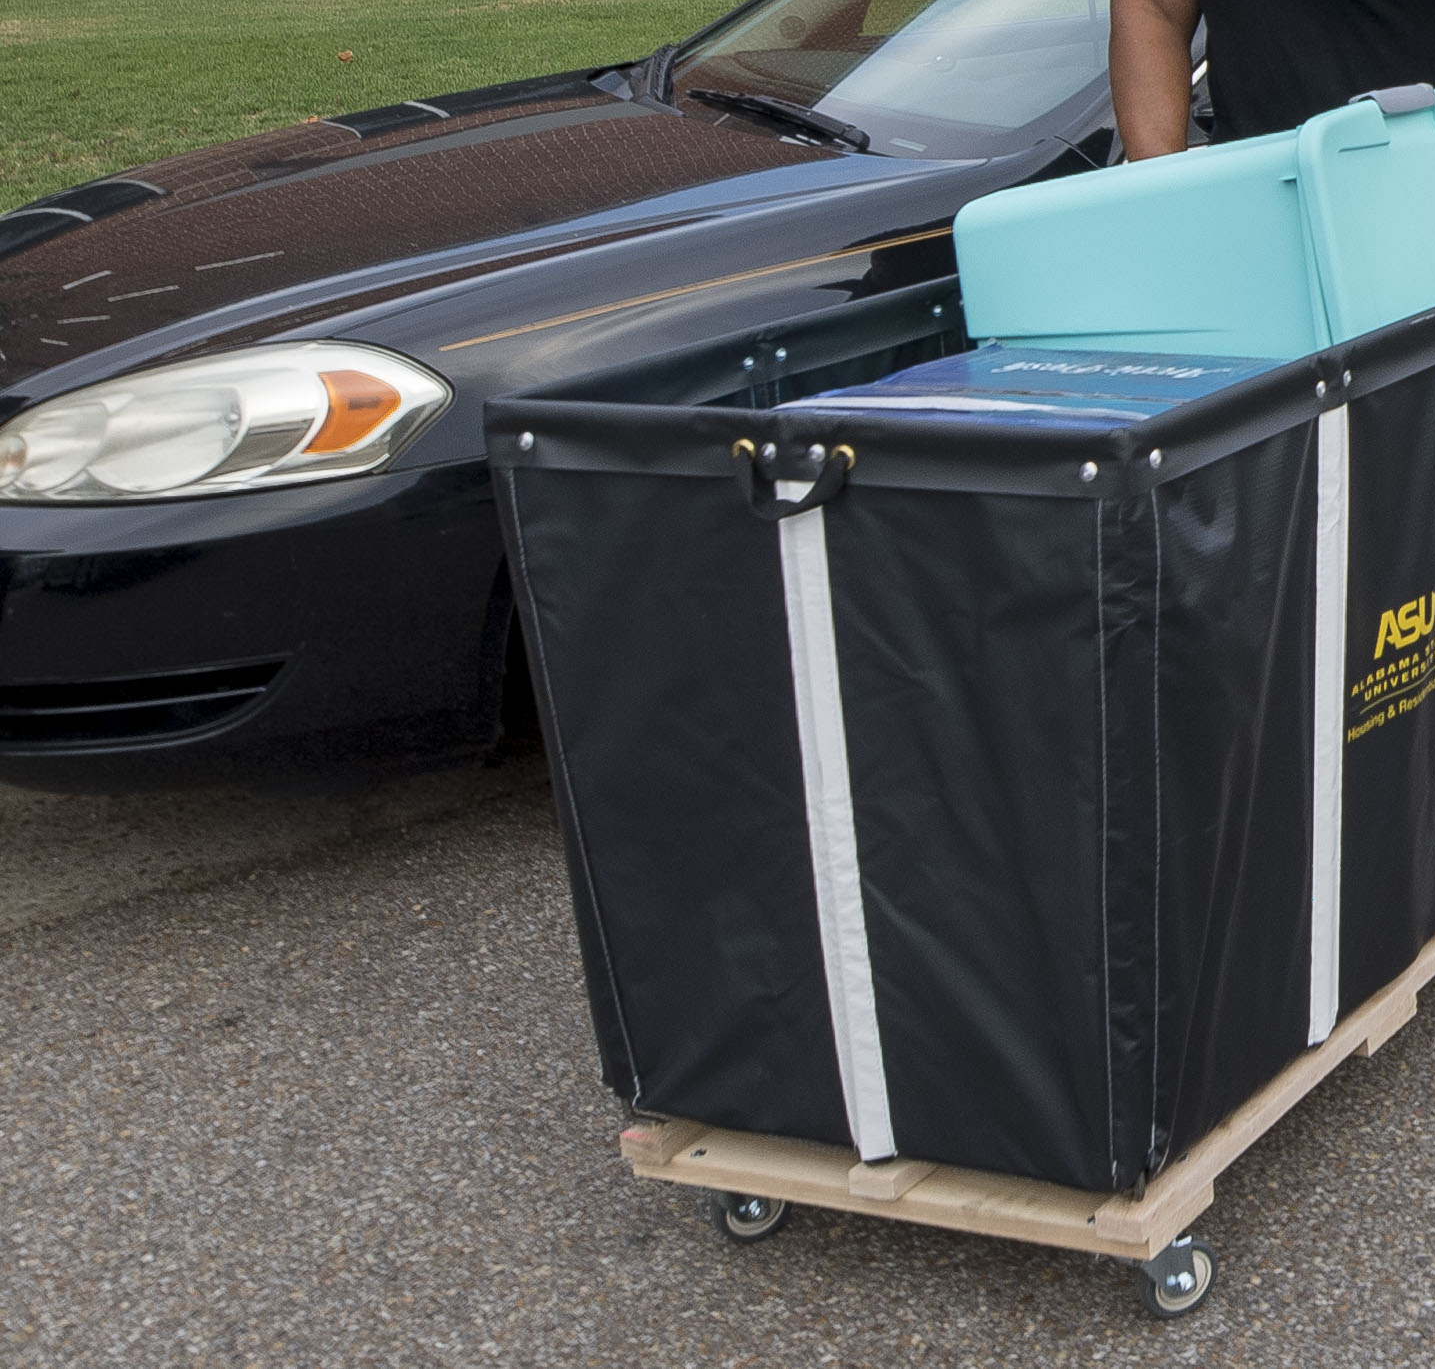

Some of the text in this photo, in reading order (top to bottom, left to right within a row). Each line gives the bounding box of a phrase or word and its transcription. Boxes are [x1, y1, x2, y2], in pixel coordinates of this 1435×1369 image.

[1351, 652, 1420, 698] ALABAMA
[1347, 712, 1385, 744] Housing
[1387, 703, 1396, 719] &
